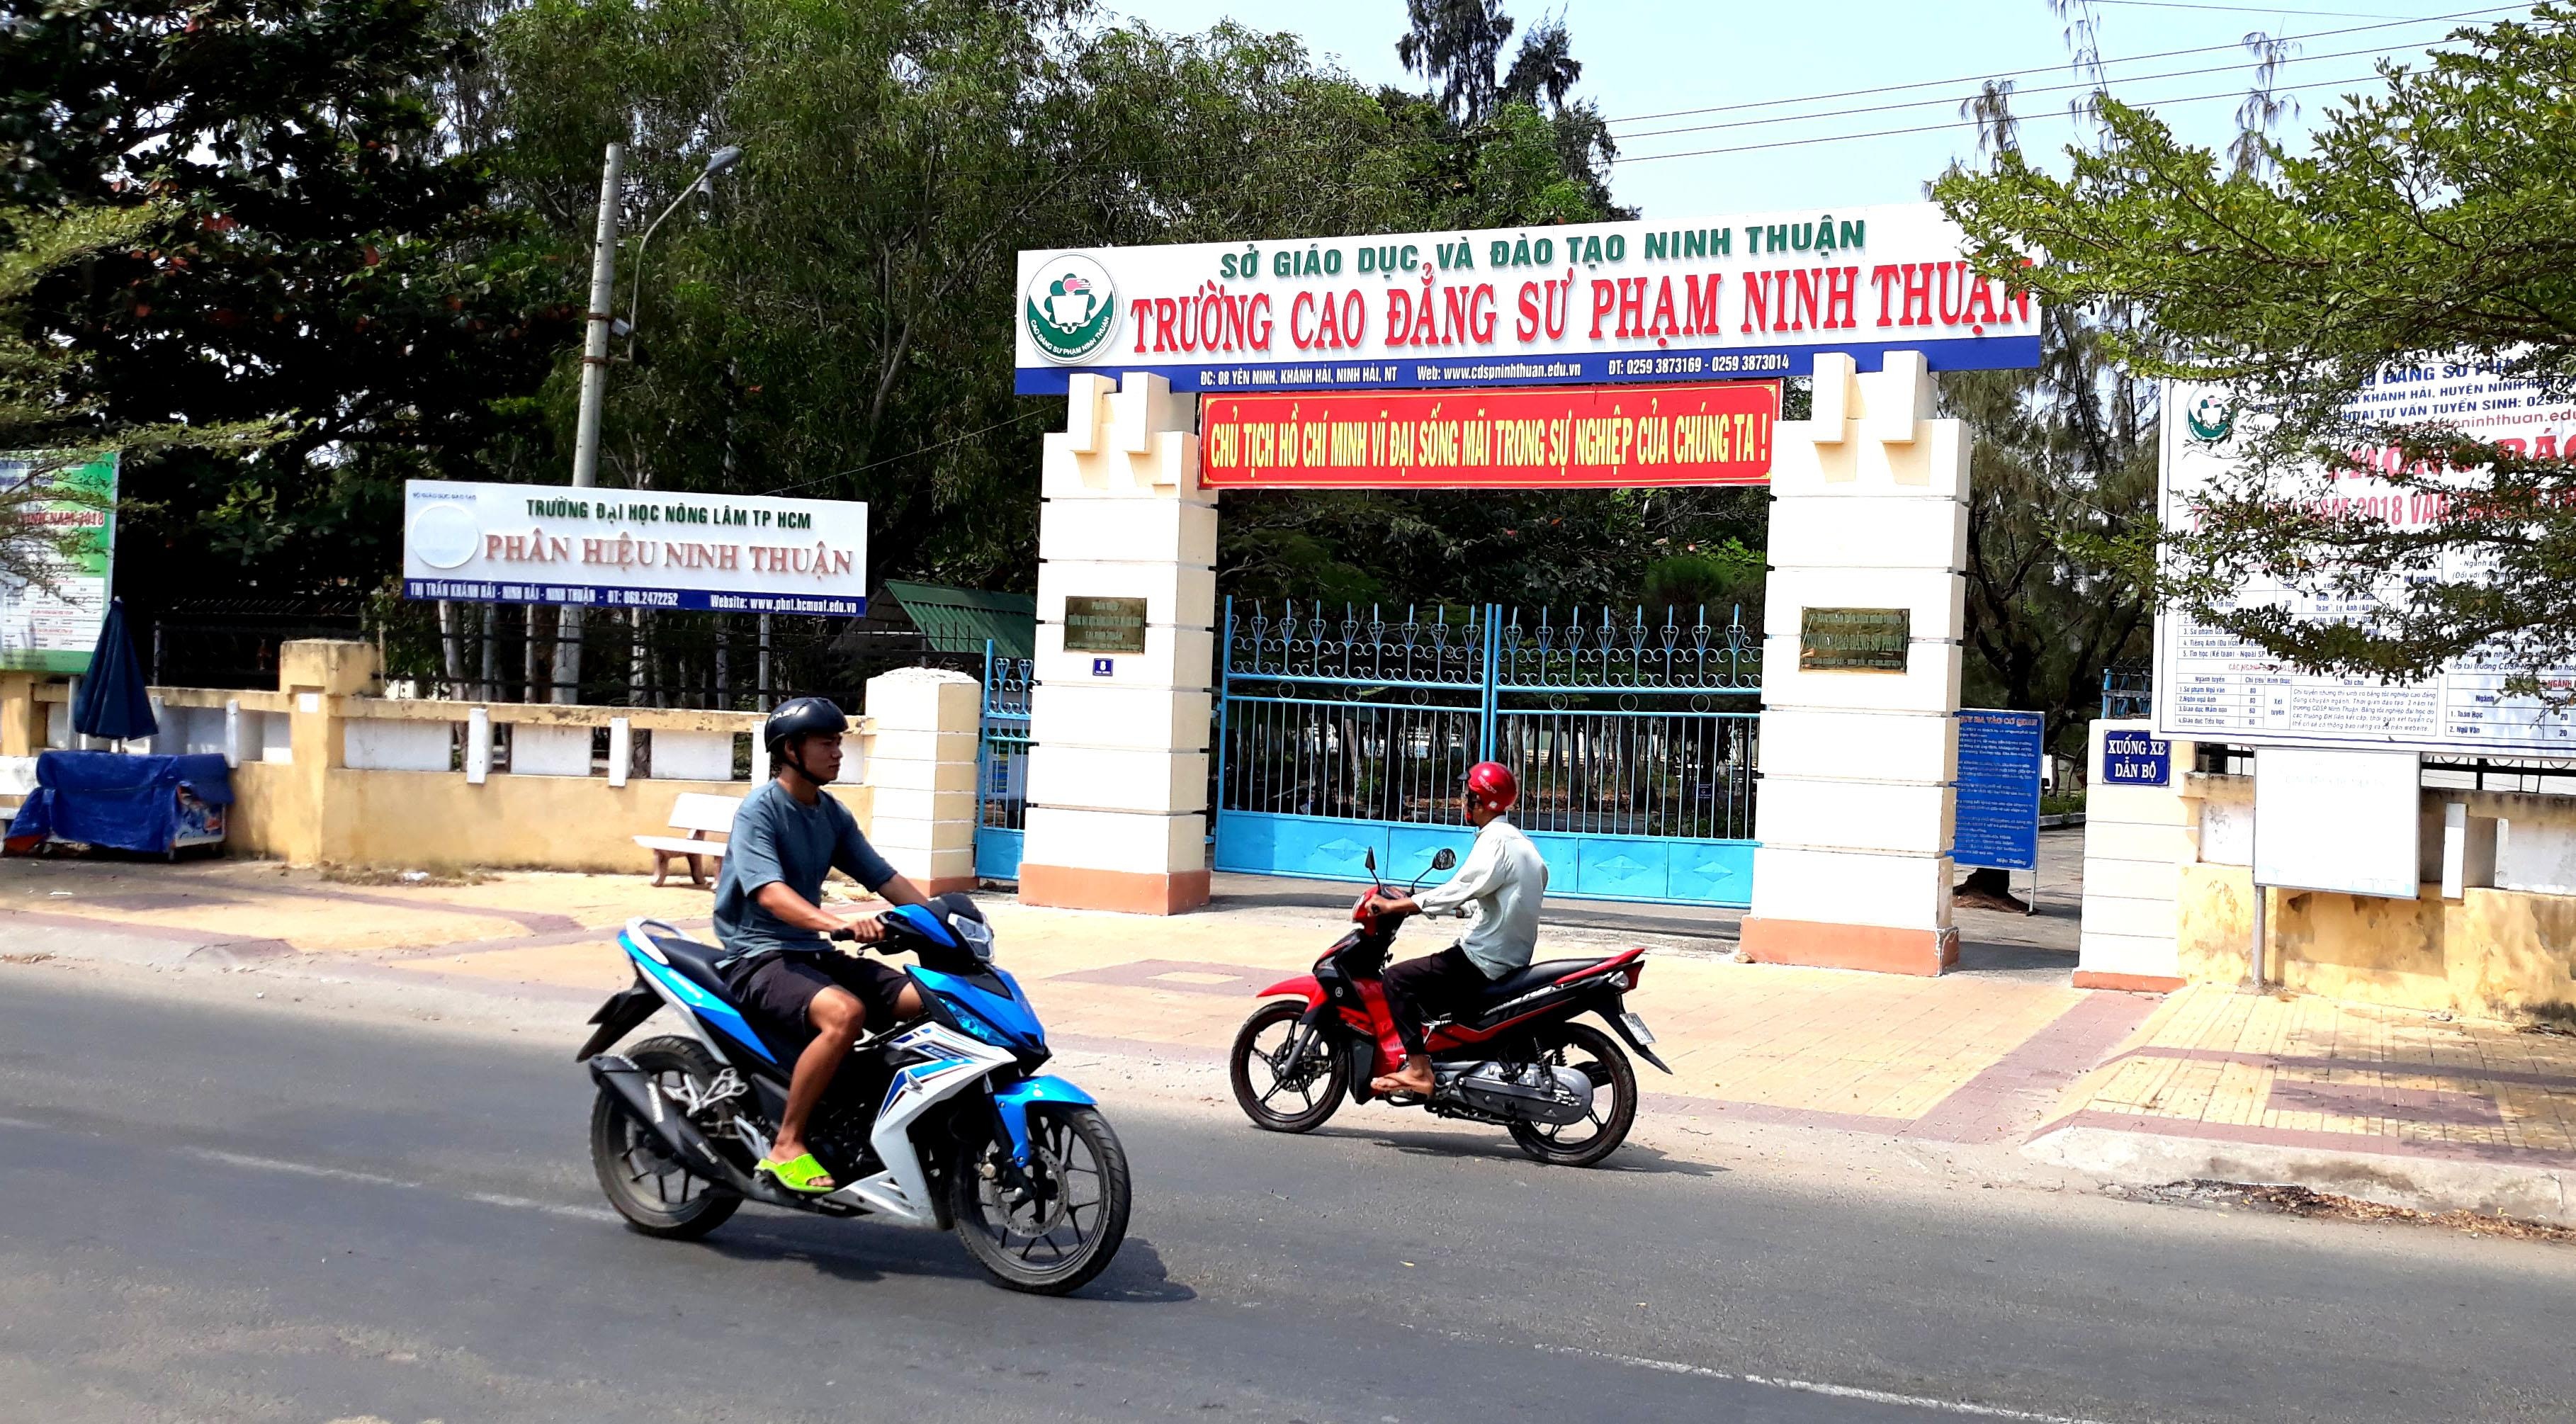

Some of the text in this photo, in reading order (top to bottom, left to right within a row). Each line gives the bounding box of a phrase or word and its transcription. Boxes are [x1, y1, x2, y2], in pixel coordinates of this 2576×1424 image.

[1220, 215, 1864, 280] SỞ GIÁO DỤC VÀ ĐÀO TẠO NINH THUẬN
[1131, 279, 1272, 354] TRƯỜNG
[1291, 289, 1365, 349] CAO
[1385, 262, 1497, 346] ĐẲNG
[1517, 266, 1574, 344] SƯ
[1589, 273, 1722, 348] PHẠM
[1741, 266, 1860, 334] NINH
[1200, 371, 1216, 386] ĐC:
[1219, 371, 1228, 385] 08
[1232, 368, 1250, 385] YÊN
[1253, 370, 1278, 385] NINH,
[1281, 365, 1313, 384] KHÁNH
[1315, 363, 1333, 383] HẢI,
[1336, 368, 1360, 383] NINH
[1362, 363, 1382, 383] HẢI,
[1384, 367, 1397, 382] NT
[1418, 366, 1441, 380] Web:
[1444, 363, 1581, 381] www.cdspninhthuan.edu.vn
[1608, 361, 1625, 375] ĐT:
[1627, 359, 1653, 374] 0259
[1656, 357, 1701, 374] 3873169
[1712, 356, 1739, 373] 0259
[1742, 354, 1790, 371] 3873014
[2432, 397, 2477, 414] TUYỂN
[2482, 397, 2521, 410] SINH:
[1211, 397, 1767, 478] CHỦ TỊCH HỒ CHÍ MINH VĨ ĐẠI SỐNG MÃI TRONG SỰ NGHIỆP CỦA CHÚNG TA !
[526, 496, 811, 529] TRƯỜNG ĐẠI HỌC NÔNG LÂM TP HCM
[485, 527, 854, 580] PHÂN HIỆU NINH THUẬN
[711, 594, 747, 609] Website:
[2108, 734, 2165, 755] XUỐNG XE
[2115, 757, 2156, 781] DẪN BỘ
